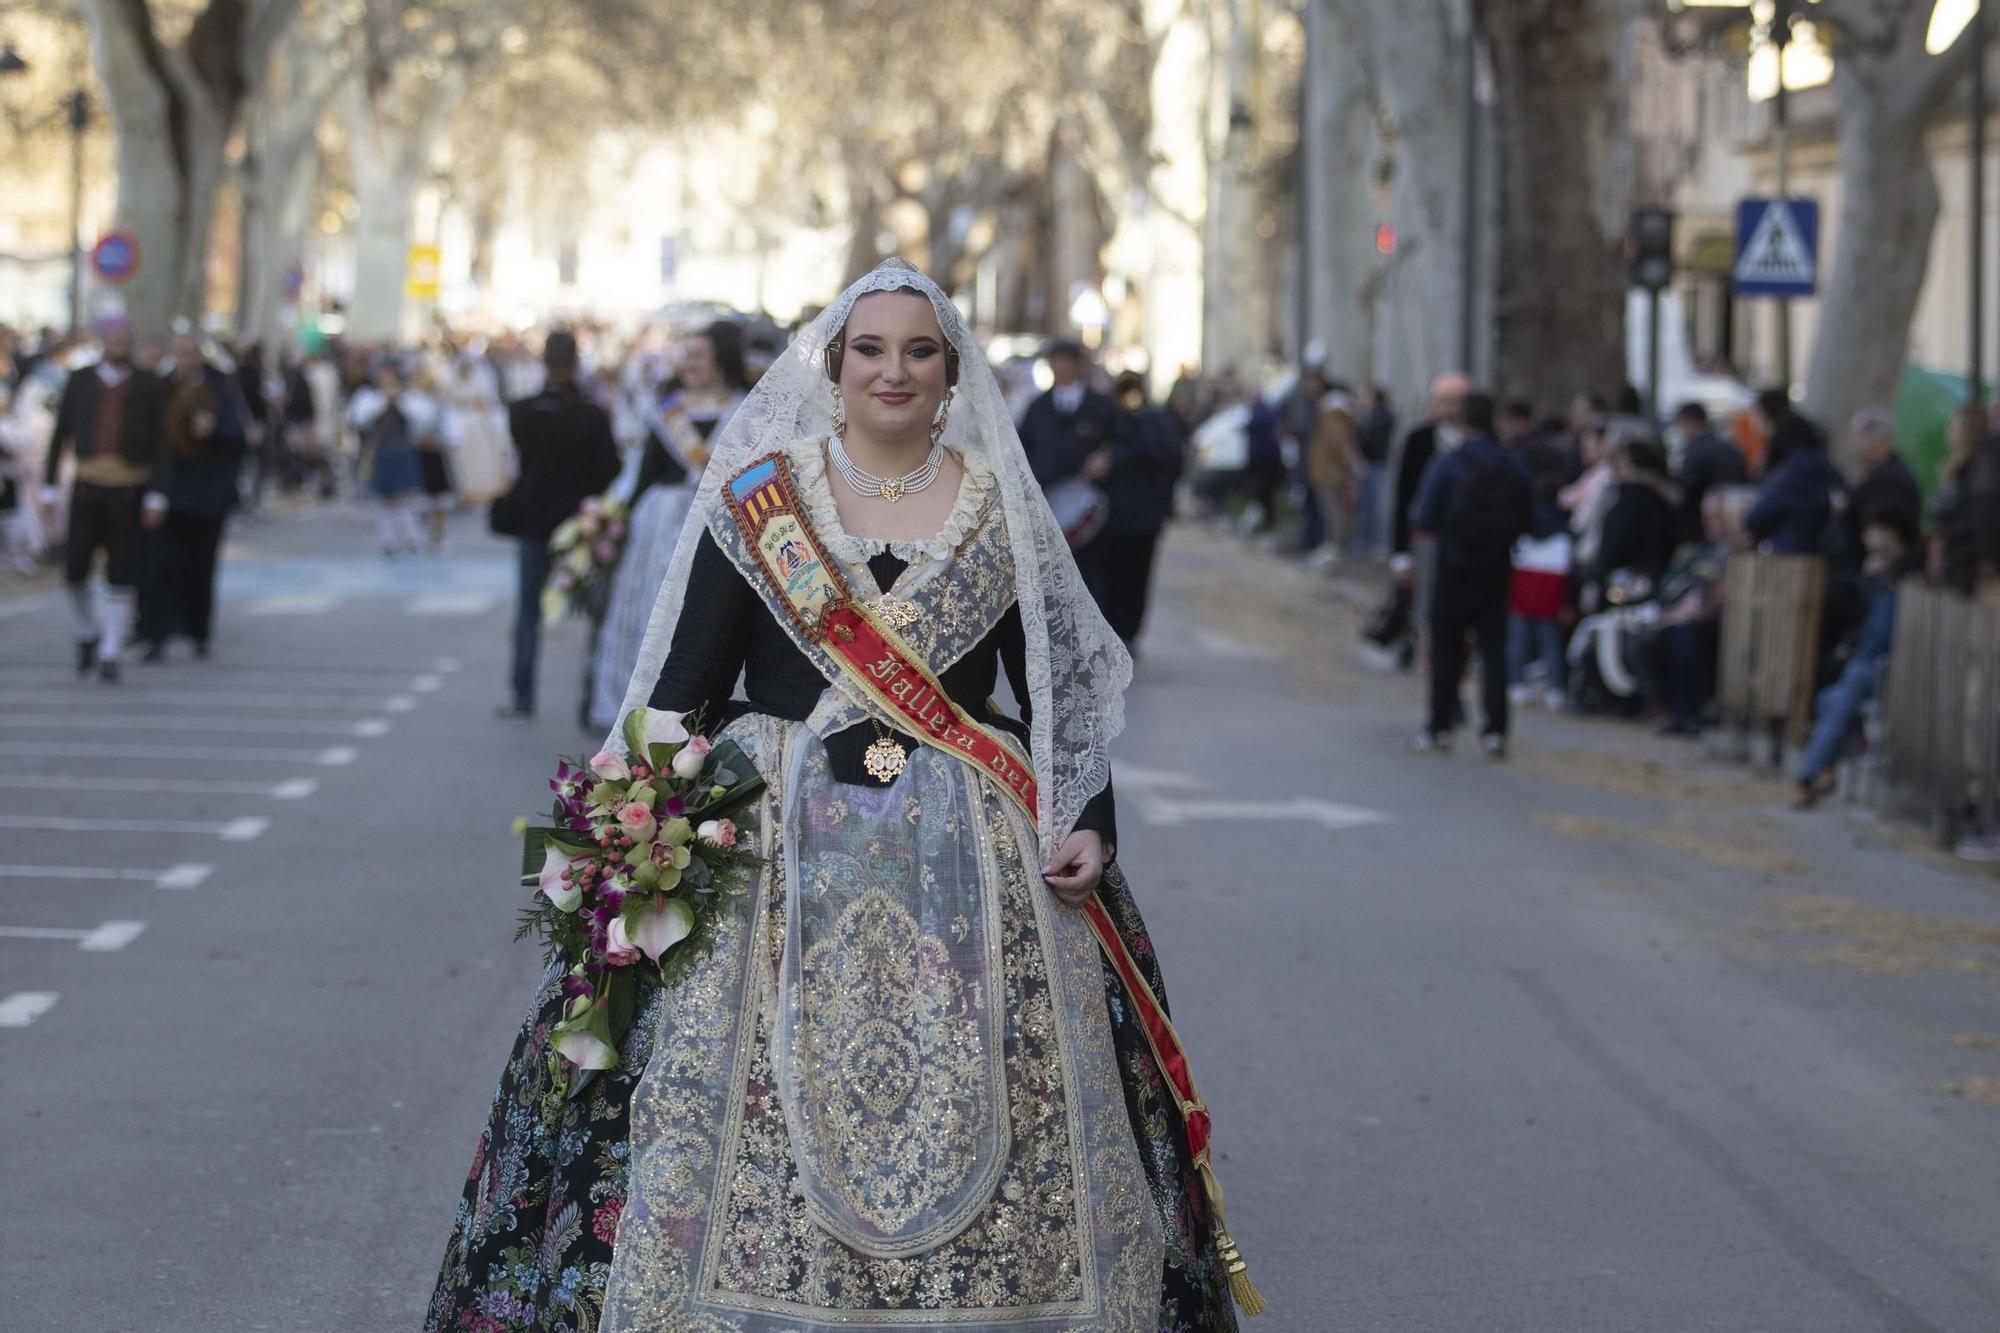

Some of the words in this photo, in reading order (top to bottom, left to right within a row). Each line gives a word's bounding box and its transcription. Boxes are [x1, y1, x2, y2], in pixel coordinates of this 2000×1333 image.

[764, 521, 797, 551] 2025
[866, 653, 976, 750] Fallera
[992, 751, 1030, 799] del
